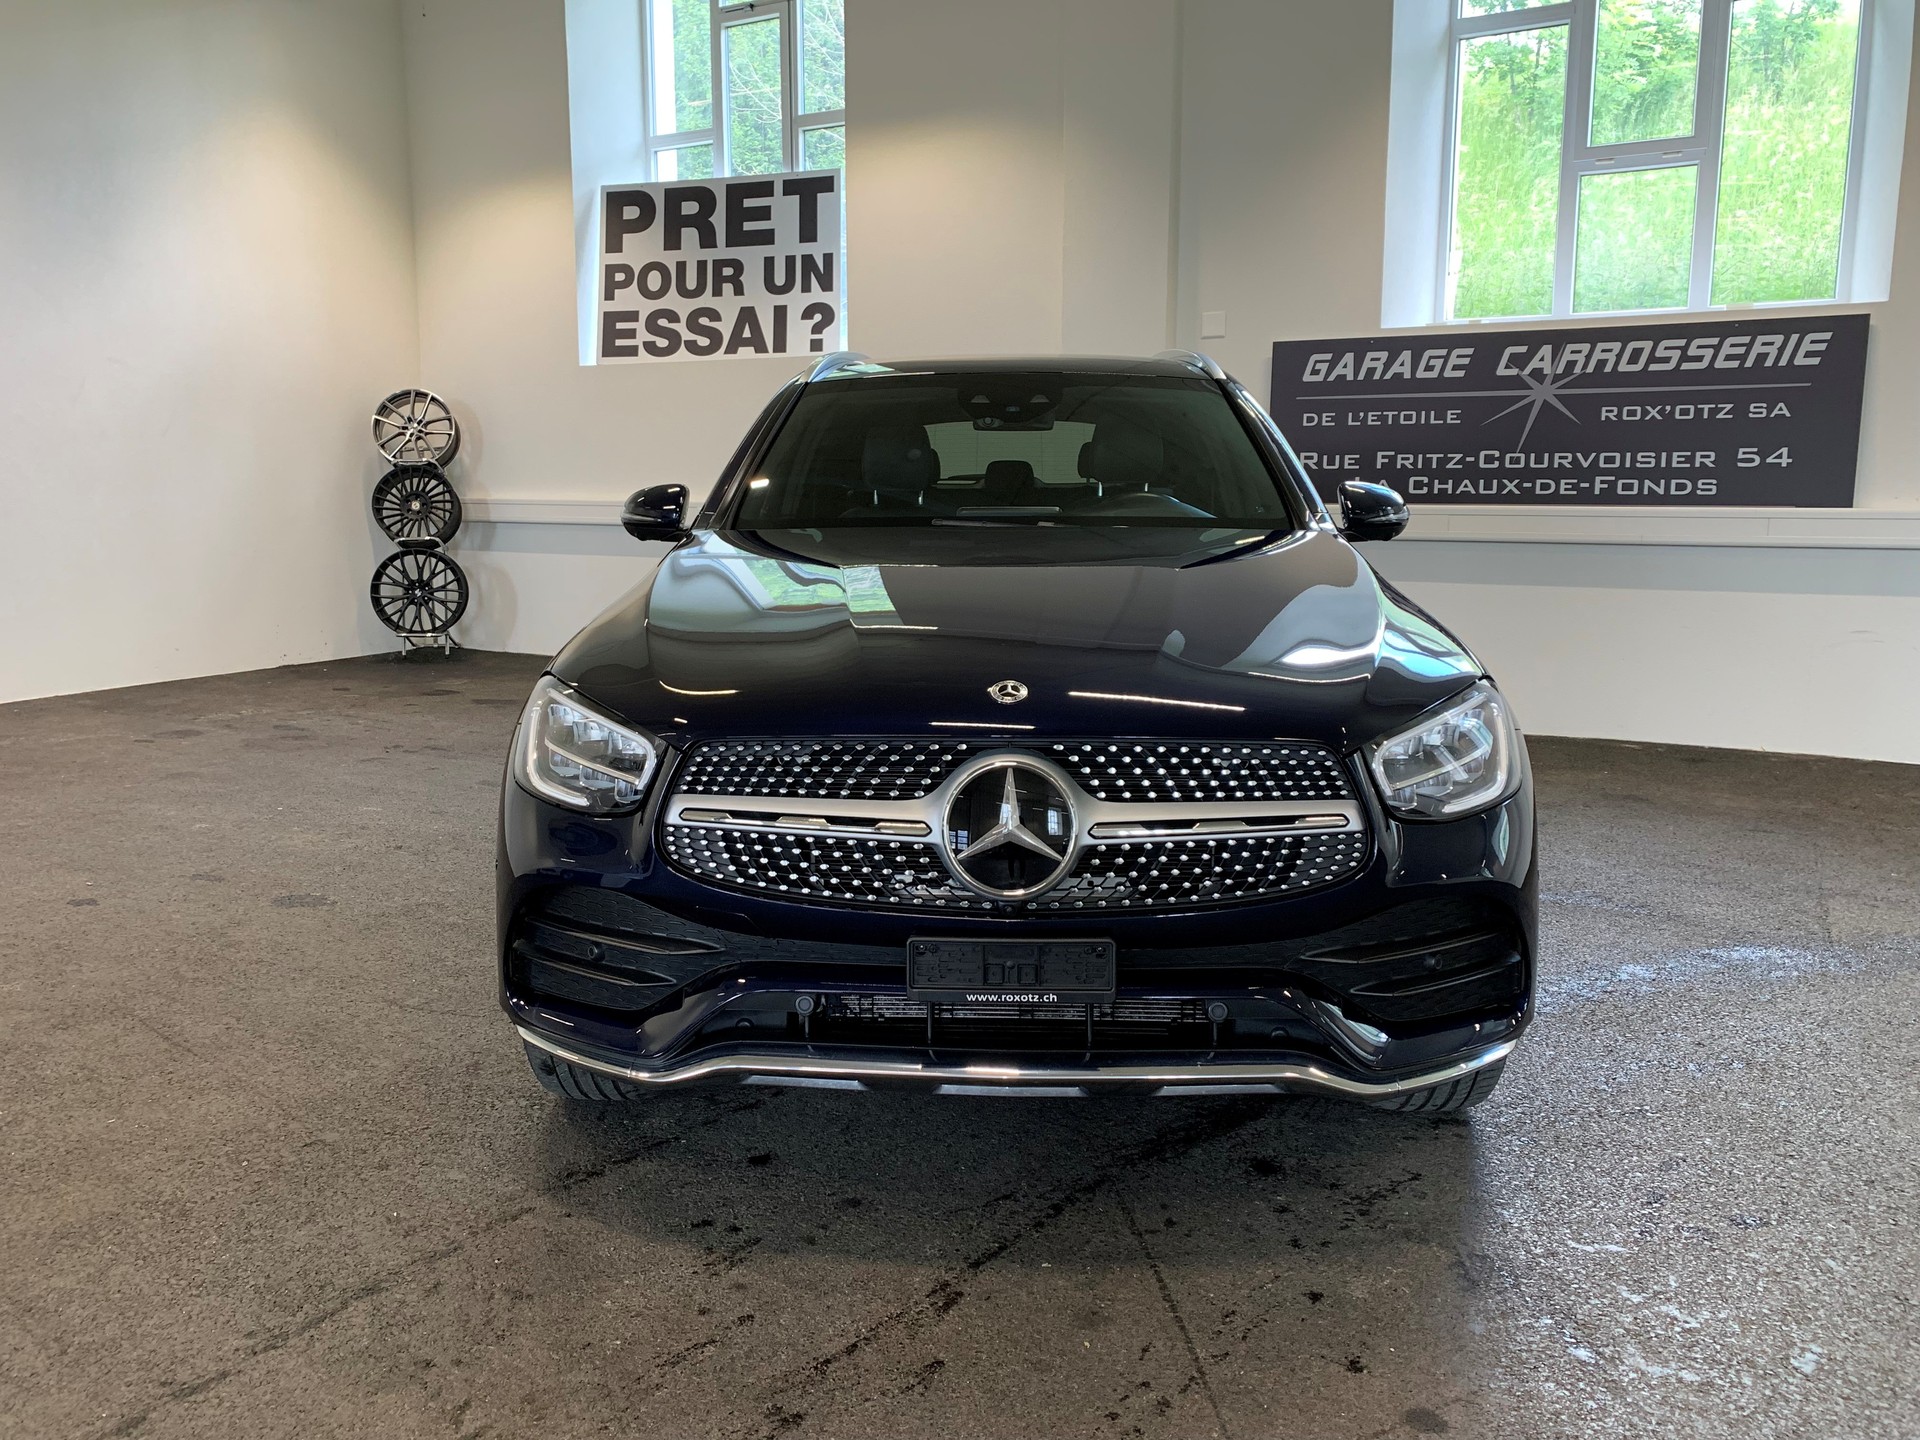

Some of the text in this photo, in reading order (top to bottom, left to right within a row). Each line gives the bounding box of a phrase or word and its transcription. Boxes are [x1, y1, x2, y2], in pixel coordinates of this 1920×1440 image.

[605, 175, 835, 253] PRET
[604, 252, 834, 301] POUR UN
[1302, 331, 1834, 382] GARAGE CARROSSERIE
[1302, 409, 1462, 427] DE L'ETOILE
[1600, 402, 1792, 421] ROX'OTZ SA
[1300, 447, 1793, 470] RUE FRITZ-COURVOISIER 54
[1408, 476, 1718, 496] CHAUX-DE-FONDS
[965, 992, 1058, 1003] www.roxotz.ch
